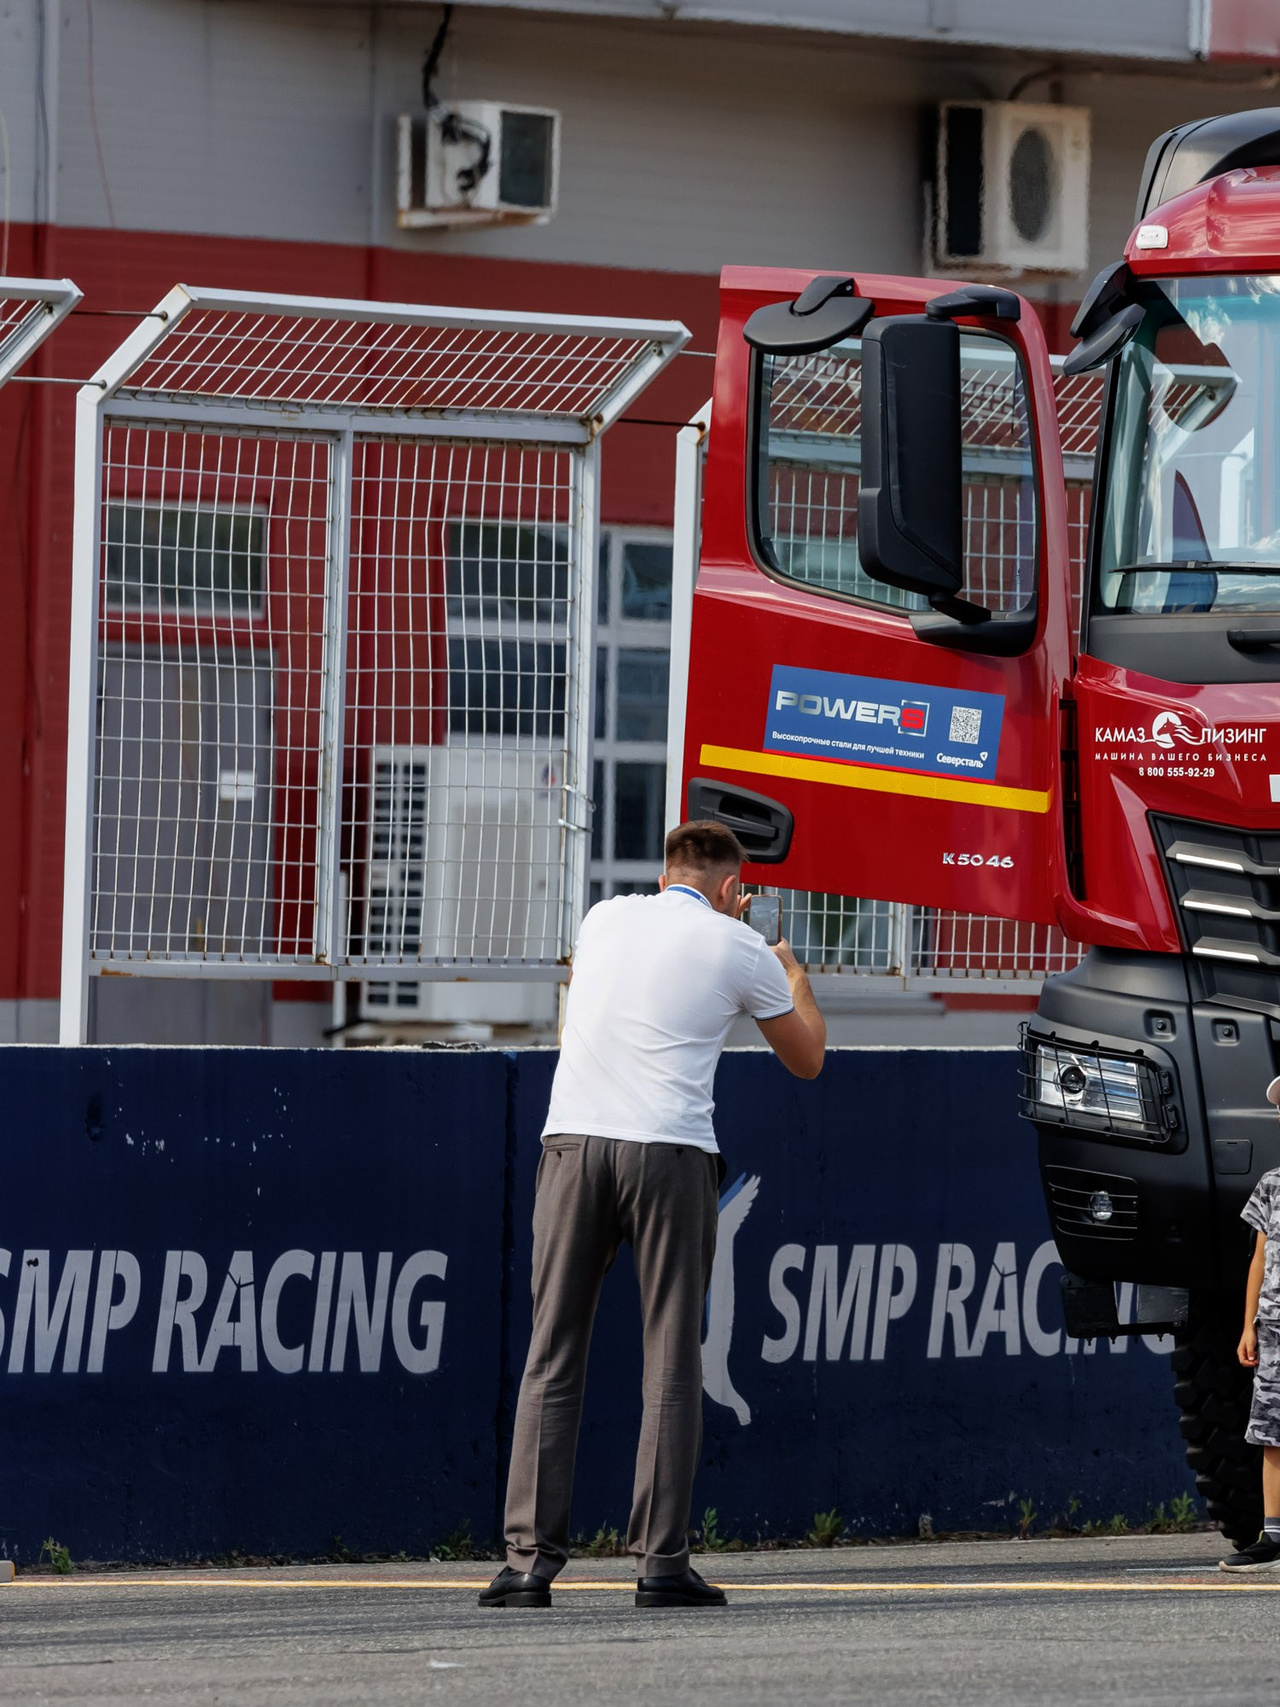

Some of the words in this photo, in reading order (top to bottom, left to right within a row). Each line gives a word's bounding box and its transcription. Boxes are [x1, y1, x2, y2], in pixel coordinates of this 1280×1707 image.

[775, 690, 925, 730] POWERS
[772, 731, 831, 746] Высокопрочные
[831, 740, 853, 749] стали
[852, 743, 866, 751] для
[866, 744, 894, 755] лучшей
[895, 748, 925, 759] техники
[1095, 727, 1146, 743] КАМАЗ
[1200, 728, 1267, 744] ЛИЗИНГ
[936, 752, 985, 769] Северсталь
[1095, 752, 1144, 761] МАШИНА
[1151, 752, 1200, 761] ВАШЕГО
[1208, 753, 1267, 762] БИЗНЕСА
[1138, 767, 1144, 777] 8
[1147, 767, 1164, 777] 800
[1167, 767, 1215, 777] 555-92-29
[152, 1249, 449, 1374] RACING
[760, 1243, 918, 1364] SMP
